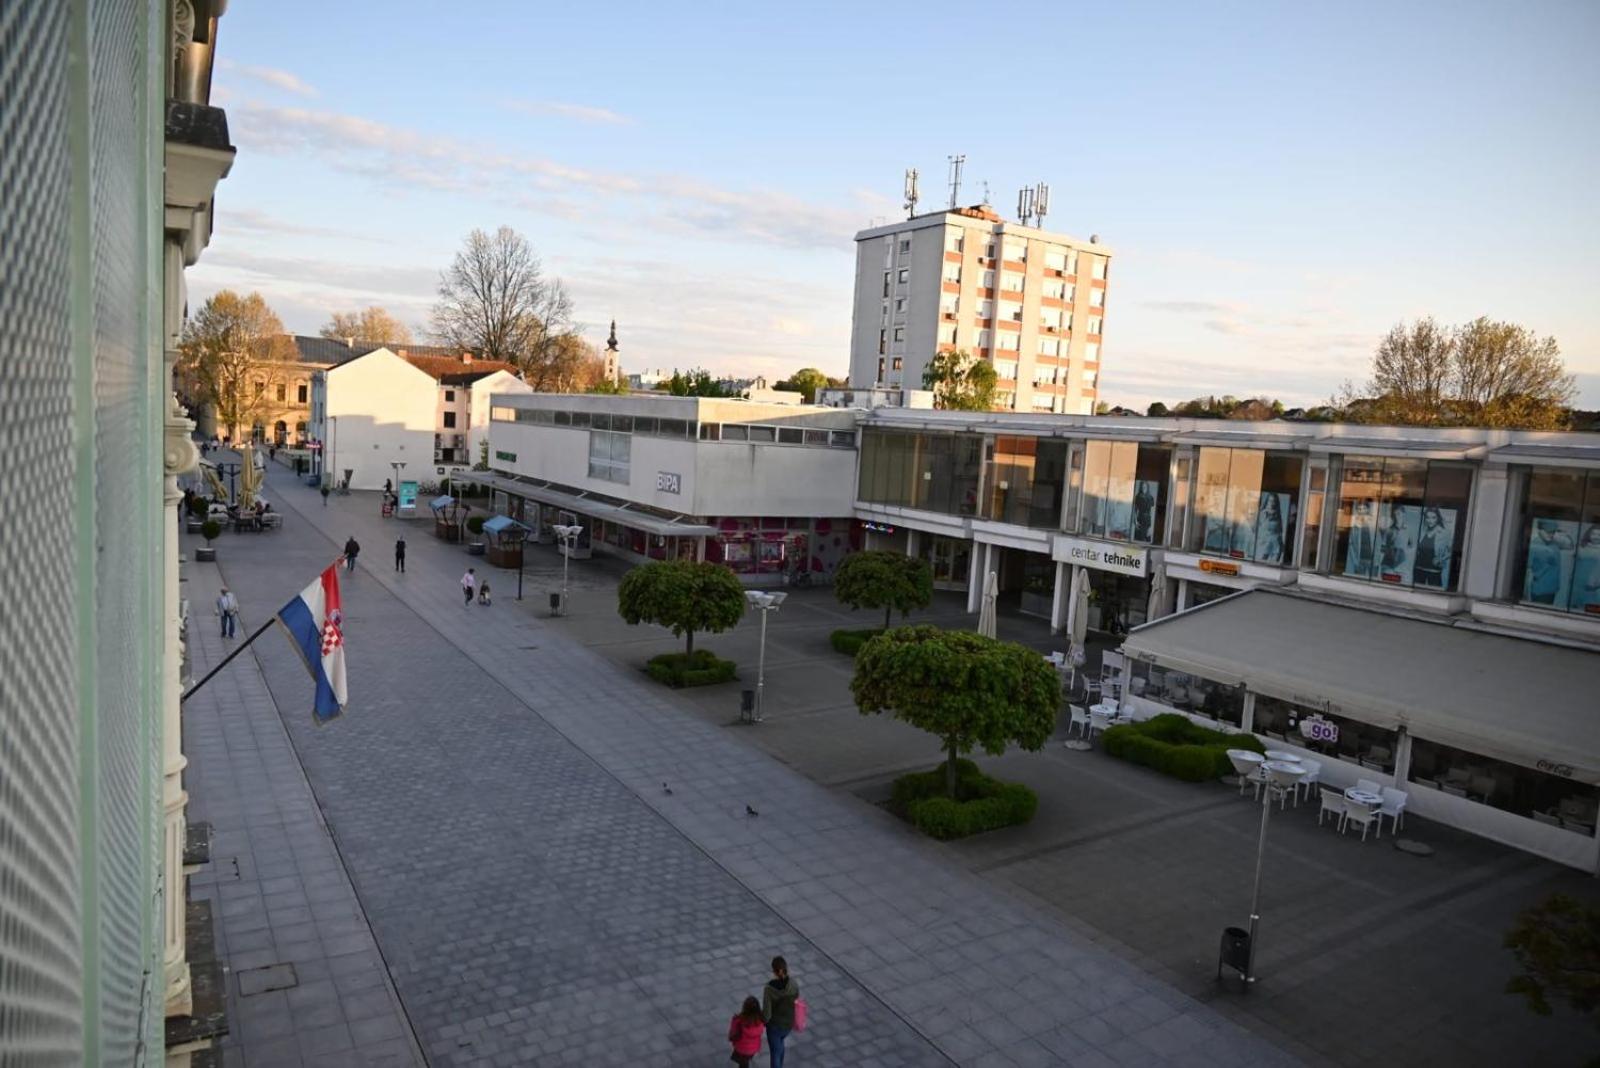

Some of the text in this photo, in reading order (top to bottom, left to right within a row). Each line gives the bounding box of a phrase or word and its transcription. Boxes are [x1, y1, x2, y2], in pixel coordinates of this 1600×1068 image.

[657, 473, 678, 492] BIPA
[1071, 547, 1141, 569] centar tehnike
